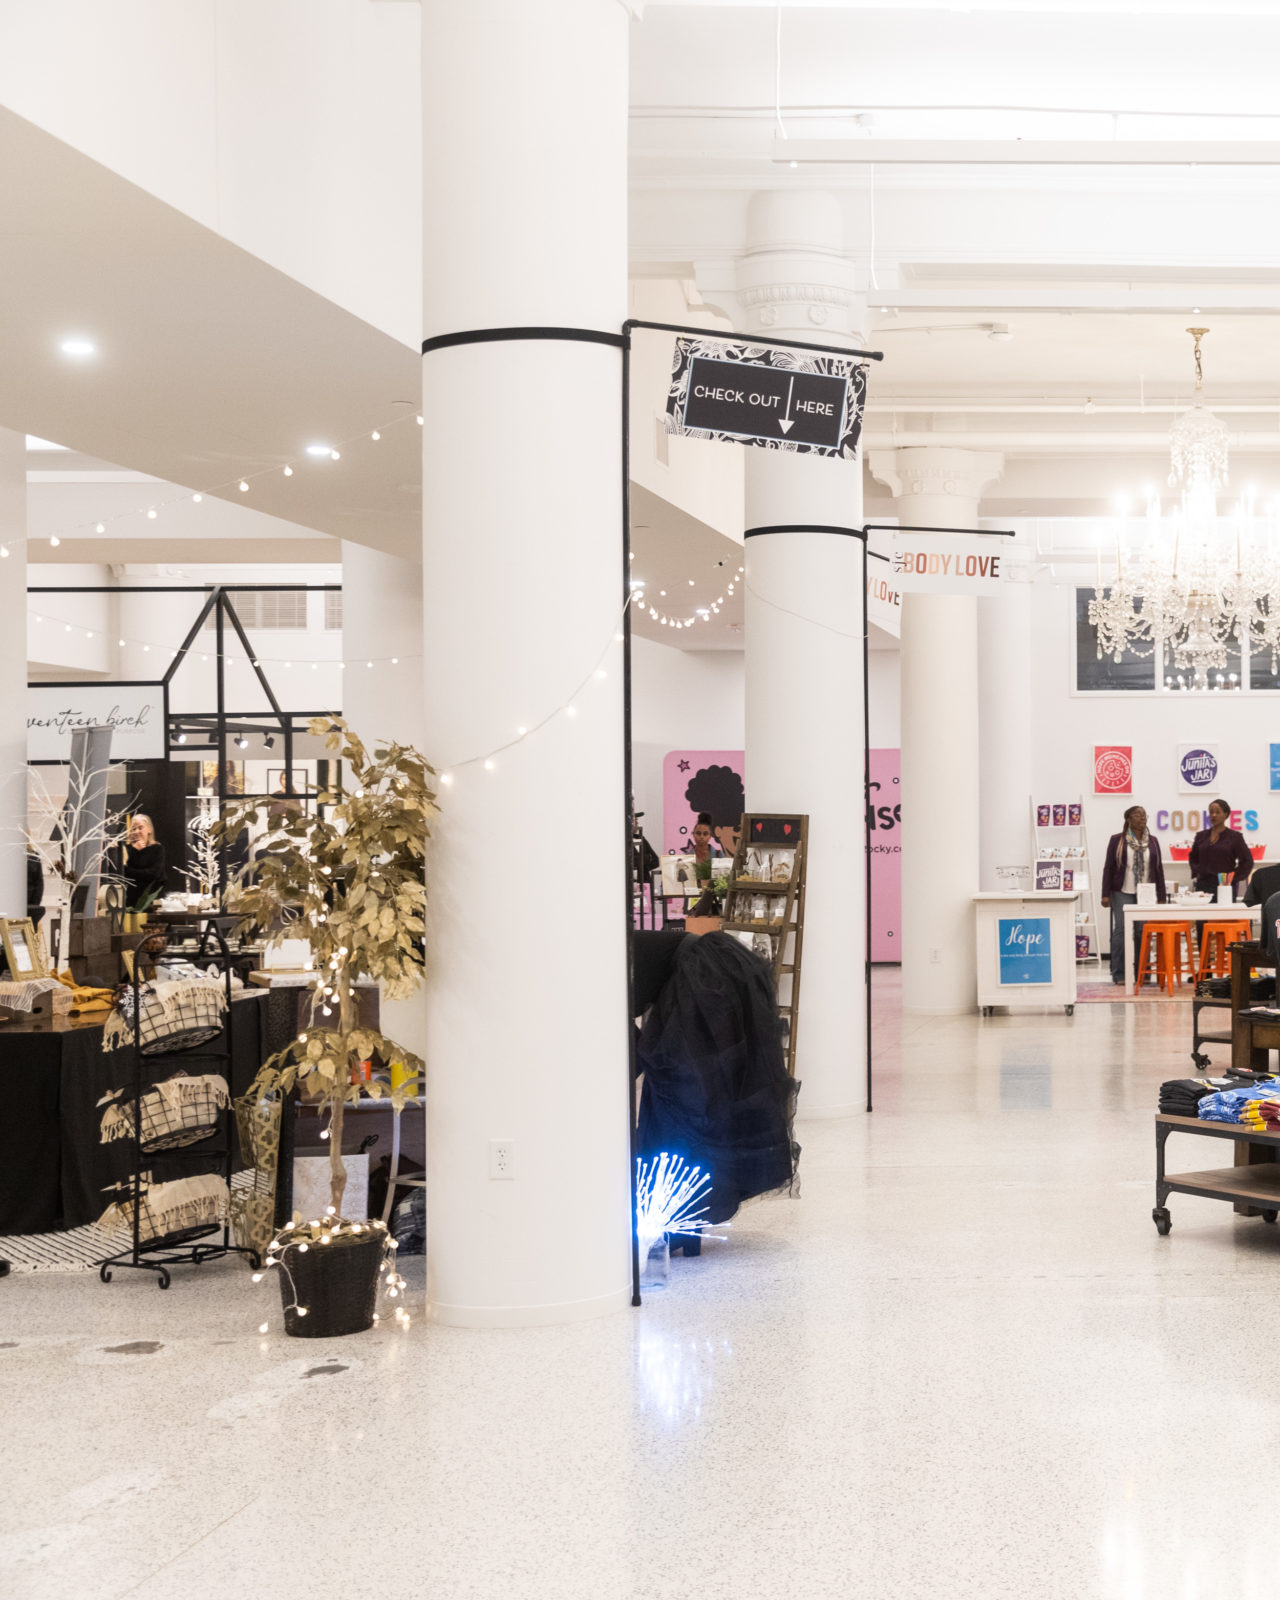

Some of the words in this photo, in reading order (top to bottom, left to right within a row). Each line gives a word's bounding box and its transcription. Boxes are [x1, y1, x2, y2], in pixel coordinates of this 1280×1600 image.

[694, 385, 745, 404] CHECK
[748, 393, 781, 408] OUT
[795, 400, 834, 416] HERE
[903, 551, 952, 576] BODY
[955, 554, 1000, 578] LOVE
[27, 709, 99, 735] venteen
[104, 704, 150, 728] birch
[1156, 809, 1259, 832] COOKES
[1005, 924, 1046, 955] Hope
